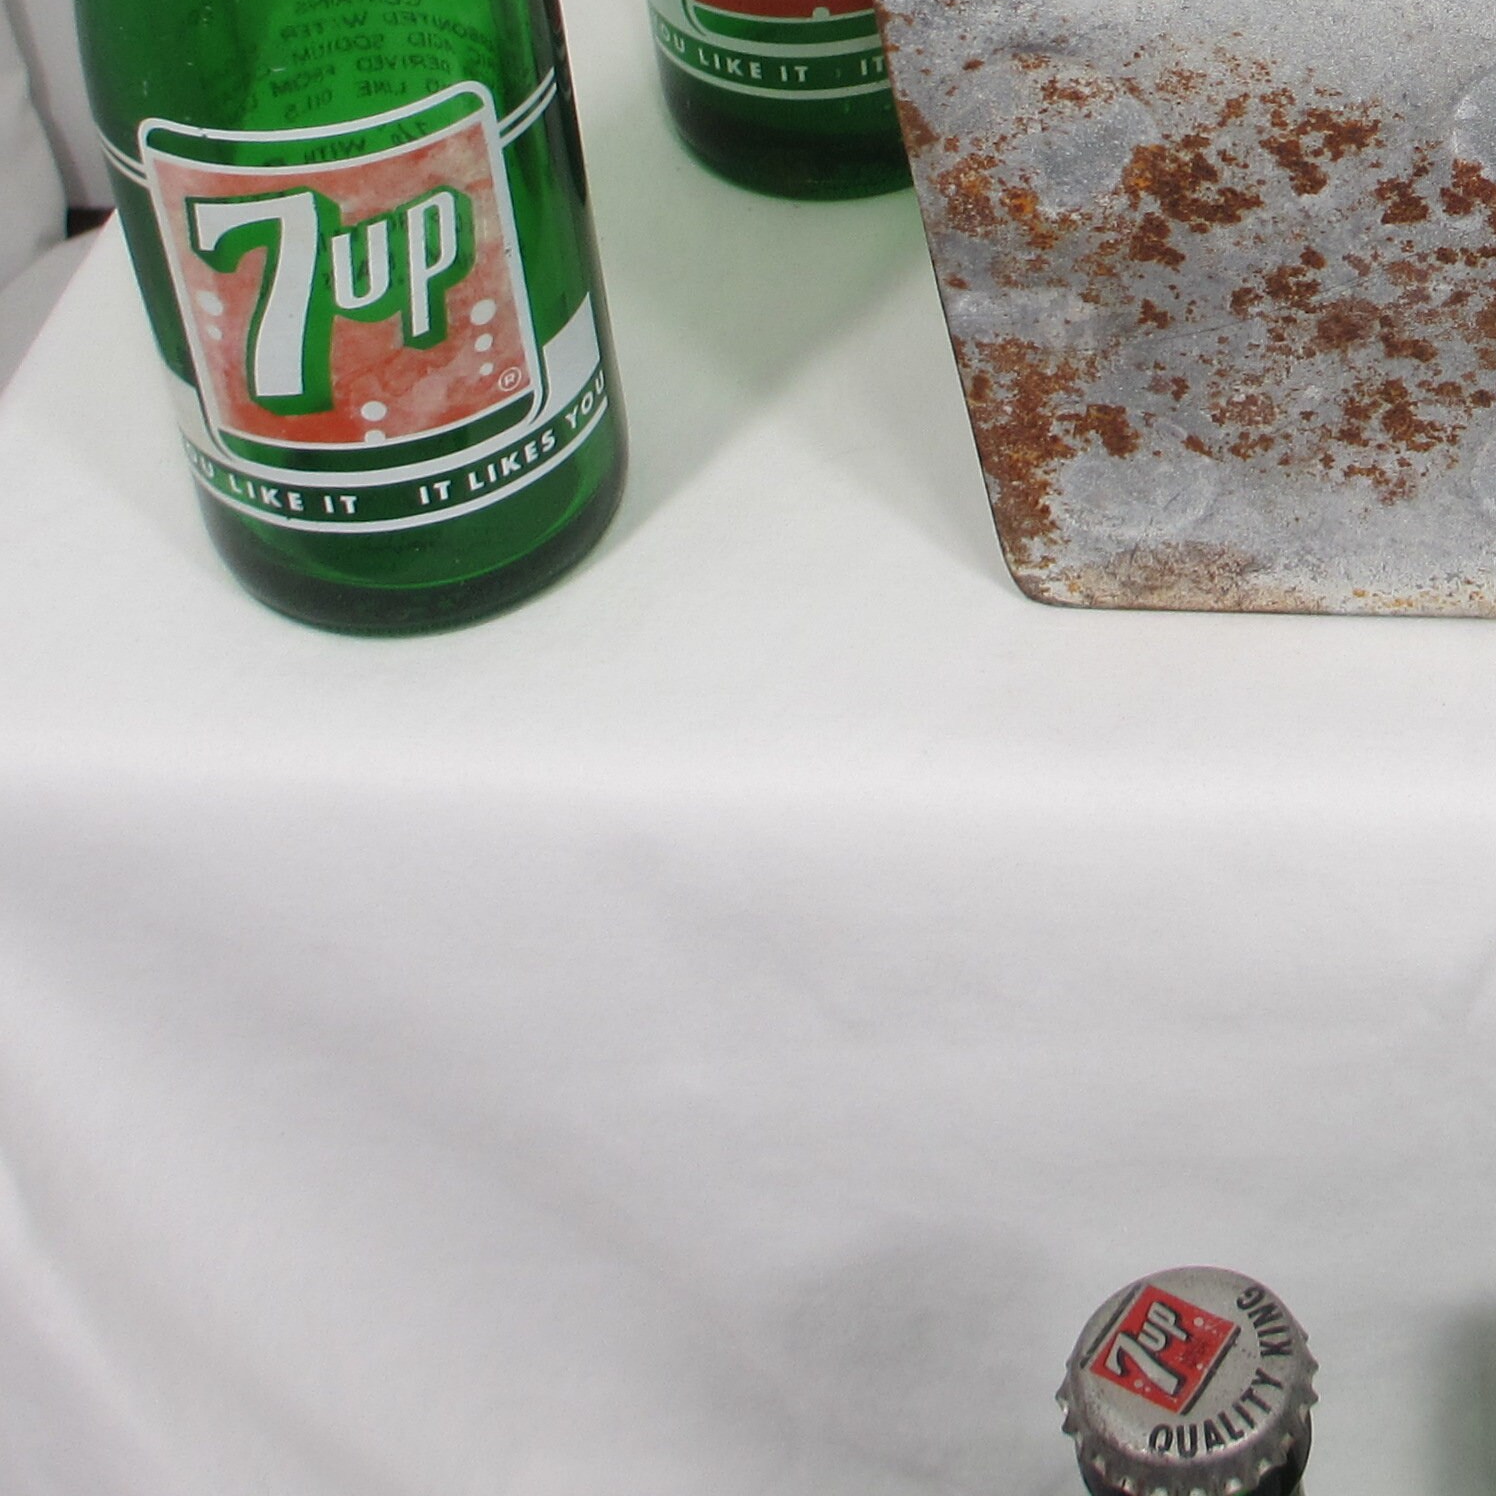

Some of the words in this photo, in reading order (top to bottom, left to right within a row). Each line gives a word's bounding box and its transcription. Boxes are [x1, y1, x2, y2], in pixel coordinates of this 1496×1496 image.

[659, 24, 686, 53] OU
[697, 47, 764, 80] LIKE
[779, 65, 809, 83] IT
[185, 440, 215, 479] OU
[228, 472, 305, 513] LIKE
[323, 494, 358, 515] IT
[419, 478, 453, 506] IT
[468, 428, 557, 493] LIKES
[565, 369, 606, 429] YOU
[1148, 1366, 1286, 1459] QUALITY
[1235, 1285, 1294, 1359] KING
